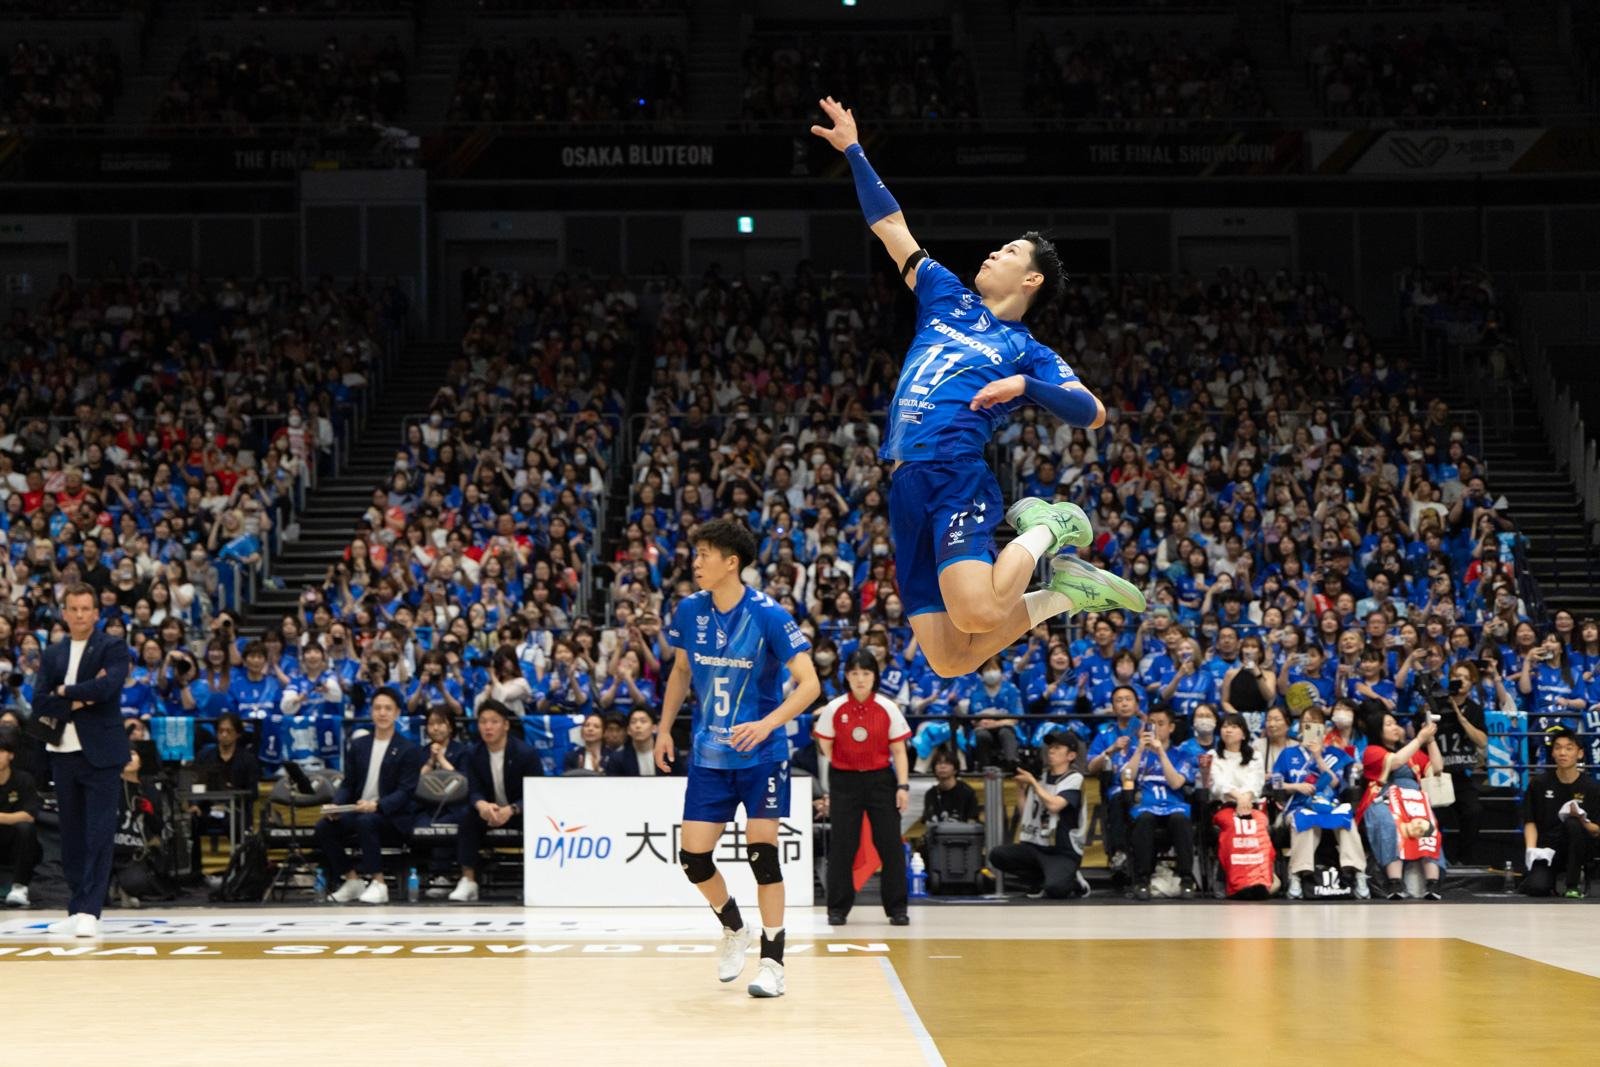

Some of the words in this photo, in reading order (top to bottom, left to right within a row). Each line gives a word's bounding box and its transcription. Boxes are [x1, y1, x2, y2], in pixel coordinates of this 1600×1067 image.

[561, 146, 624, 168] OSAKA
[628, 145, 714, 166] BLUTEON
[1088, 144, 1120, 162] THE
[1125, 144, 1173, 163] FINAL
[1178, 144, 1277, 162] SHOWDOWN
[926, 318, 1003, 366] Panasonic
[912, 343, 965, 386] 11
[693, 652, 754, 670] Panasonic
[714, 676, 731, 718] 5
[767, 778, 776, 794] 5
[535, 836, 612, 868] DAIDO
[625, 822, 803, 865] 大生命
